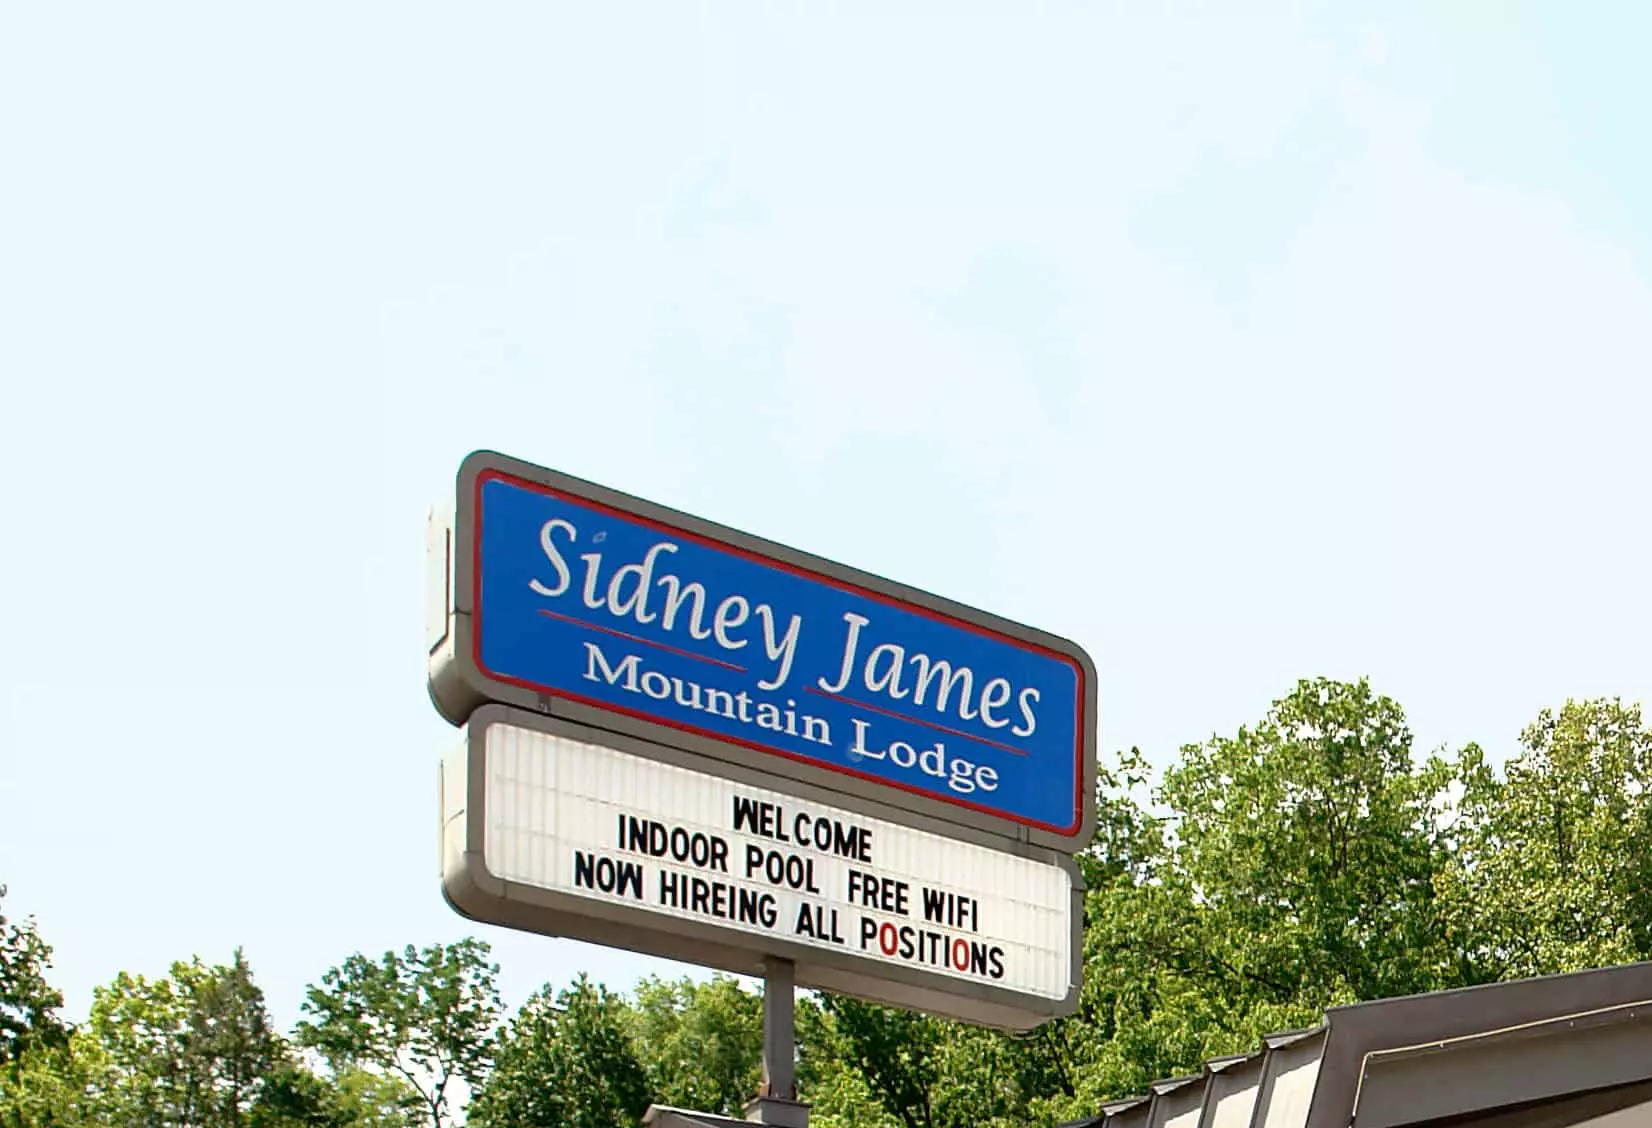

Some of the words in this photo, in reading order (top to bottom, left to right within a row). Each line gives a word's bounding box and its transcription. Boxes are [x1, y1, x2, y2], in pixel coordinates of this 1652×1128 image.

[529, 518, 801, 691] Sidney
[818, 612, 1041, 737] James
[582, 642, 833, 746] Mountain
[851, 718, 999, 793] Lodge
[618, 813, 729, 873] INDOOR
[746, 844, 820, 894] POOL
[848, 868, 909, 915] FREE
[923, 887, 978, 932] WIFI
[733, 795, 872, 863] WELCOME
[574, 850, 643, 900] NOW
[660, 869, 777, 928] HIREING
[796, 902, 845, 944] ALL
[861, 916, 1005, 979] POSITIONS
